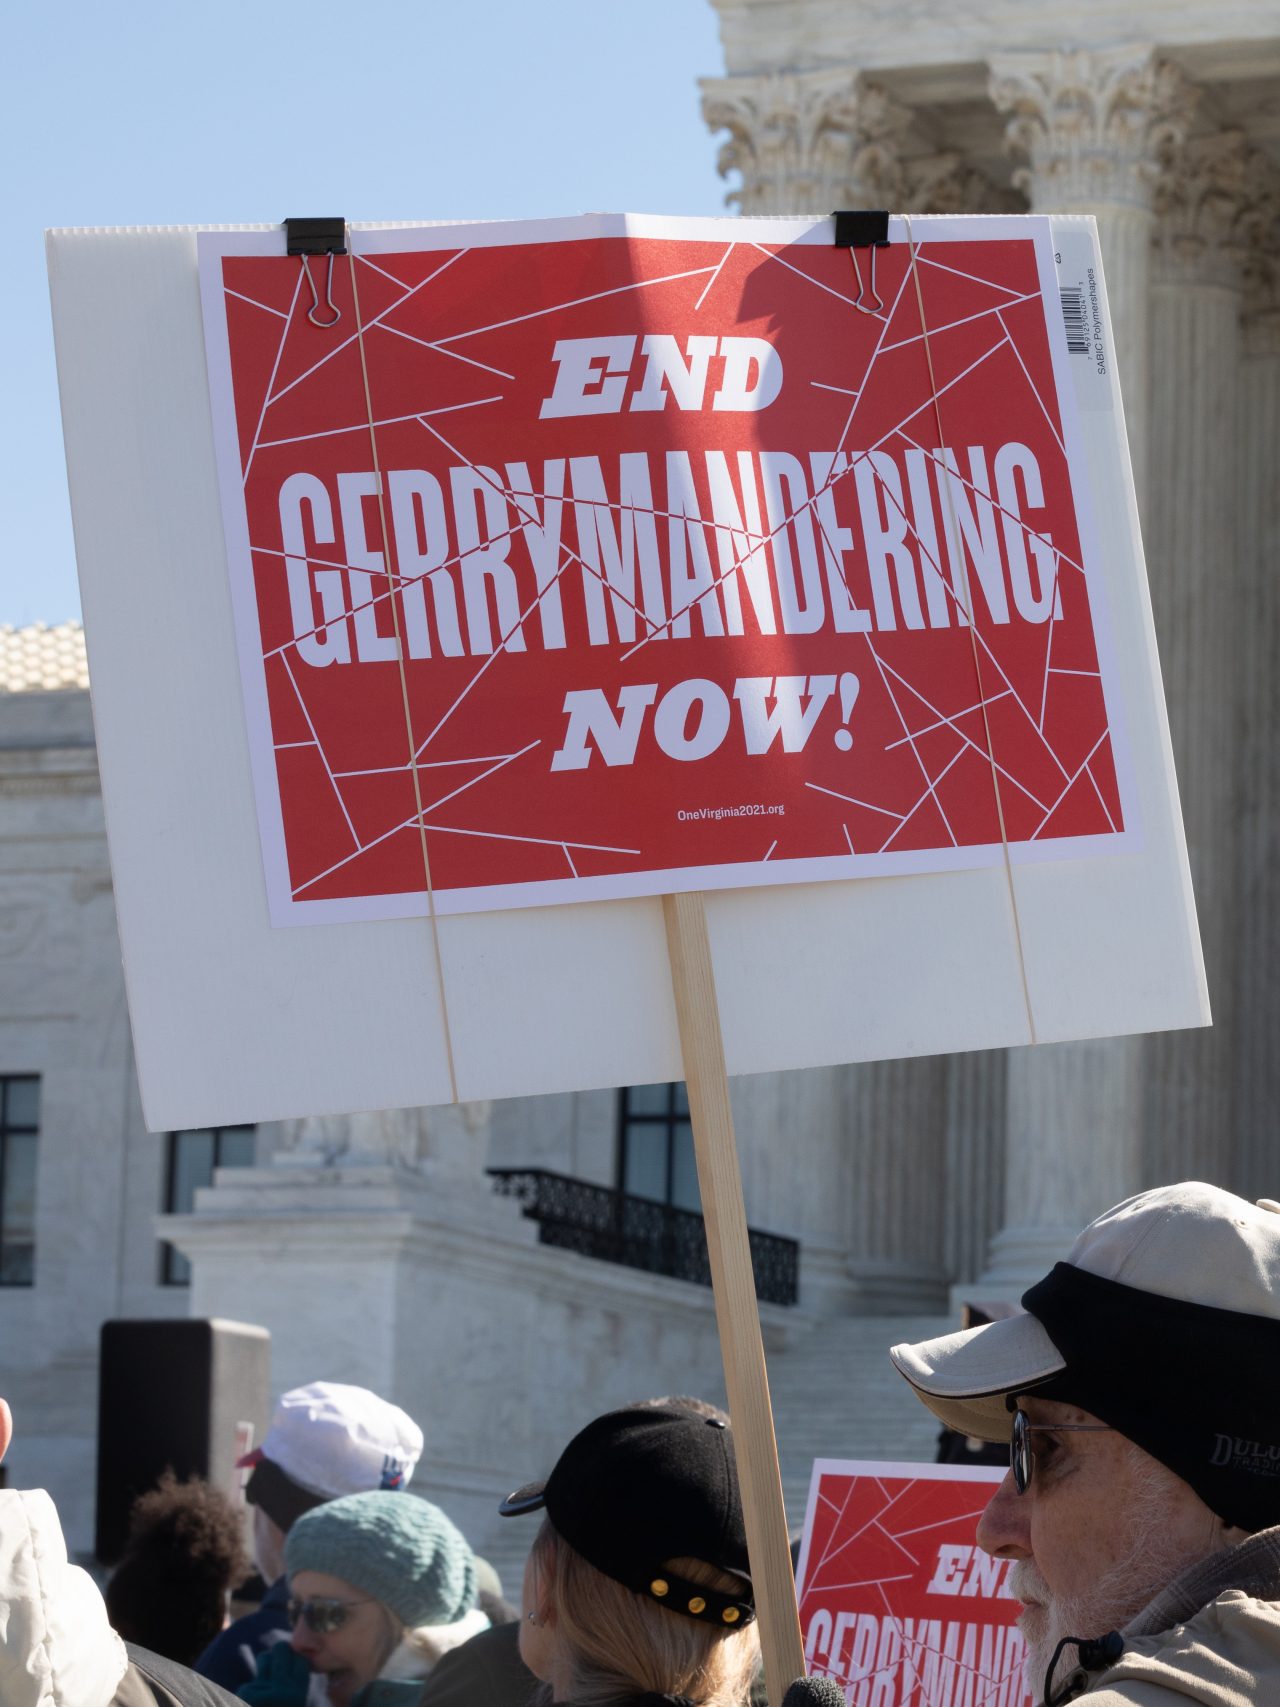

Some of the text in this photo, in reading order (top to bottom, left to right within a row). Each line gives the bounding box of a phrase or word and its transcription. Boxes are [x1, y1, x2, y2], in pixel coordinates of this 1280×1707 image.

[1087, 268, 1106, 375] SABIC Polymershapes
[538, 334, 784, 420] END
[277, 442, 1064, 668] GERRYMANDERING
[550, 671, 860, 772] NOW!
[677, 804, 785, 821] OneVirginia2021.org
